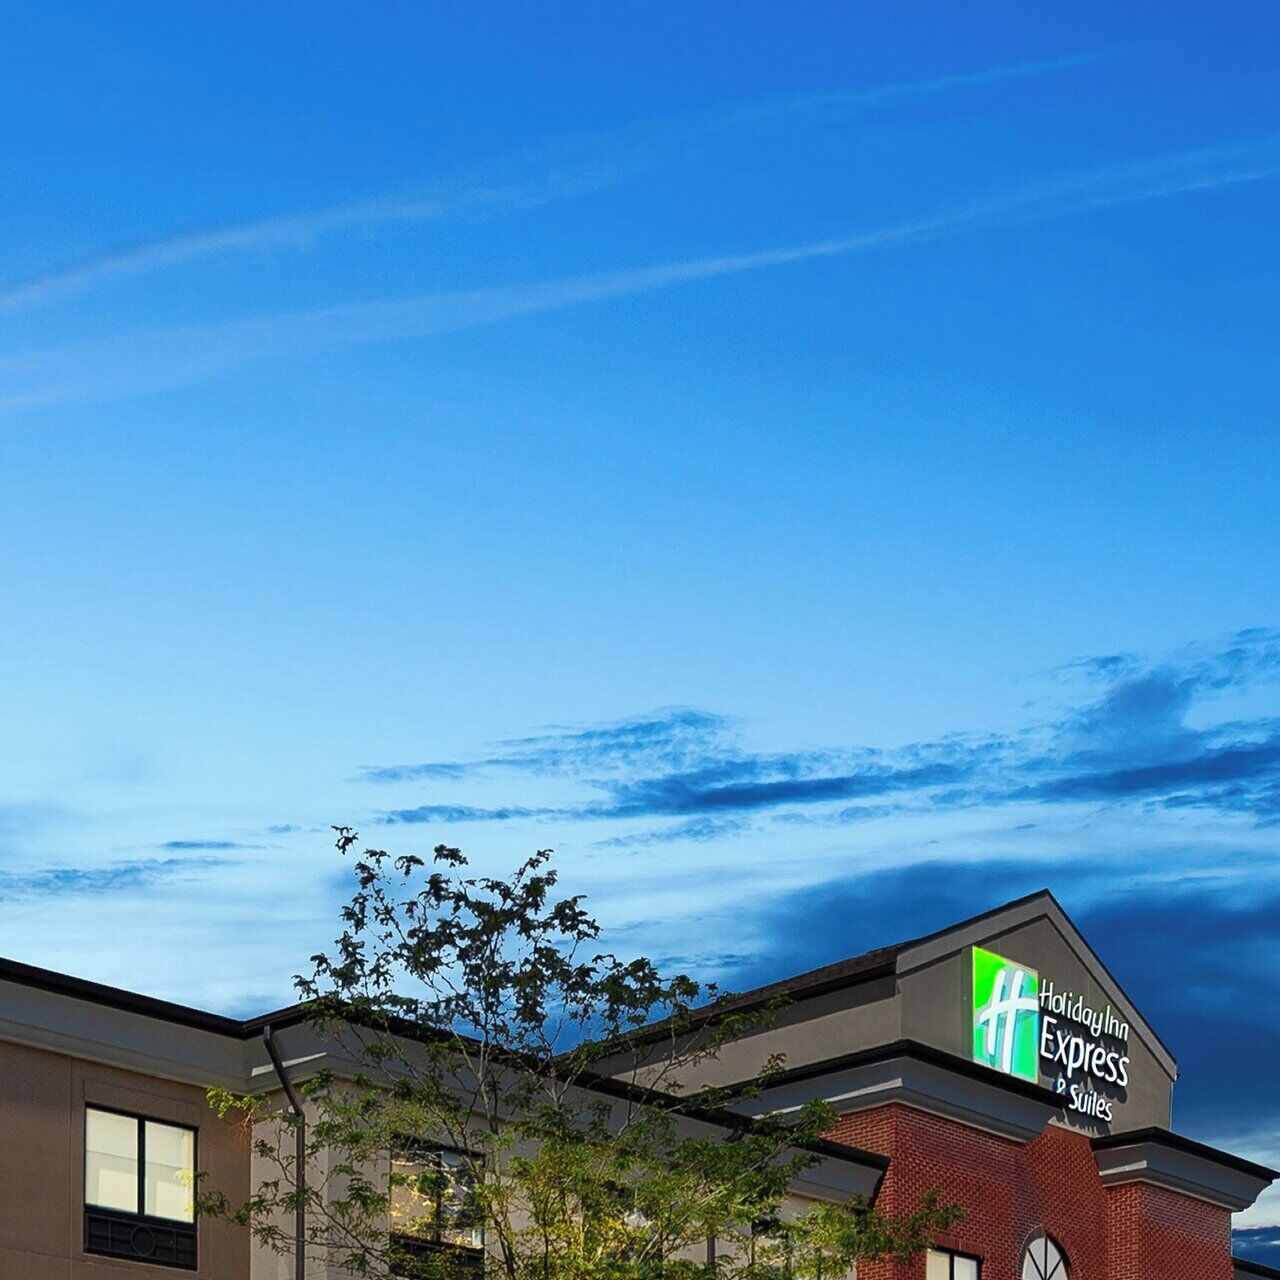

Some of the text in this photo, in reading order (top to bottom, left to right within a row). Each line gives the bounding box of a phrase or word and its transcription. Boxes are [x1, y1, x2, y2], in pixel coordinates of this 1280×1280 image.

[1039, 979, 1130, 1041] Holiday Inn
[1040, 1015, 1130, 1087] Express
[1068, 1084, 1113, 1122] Suites
